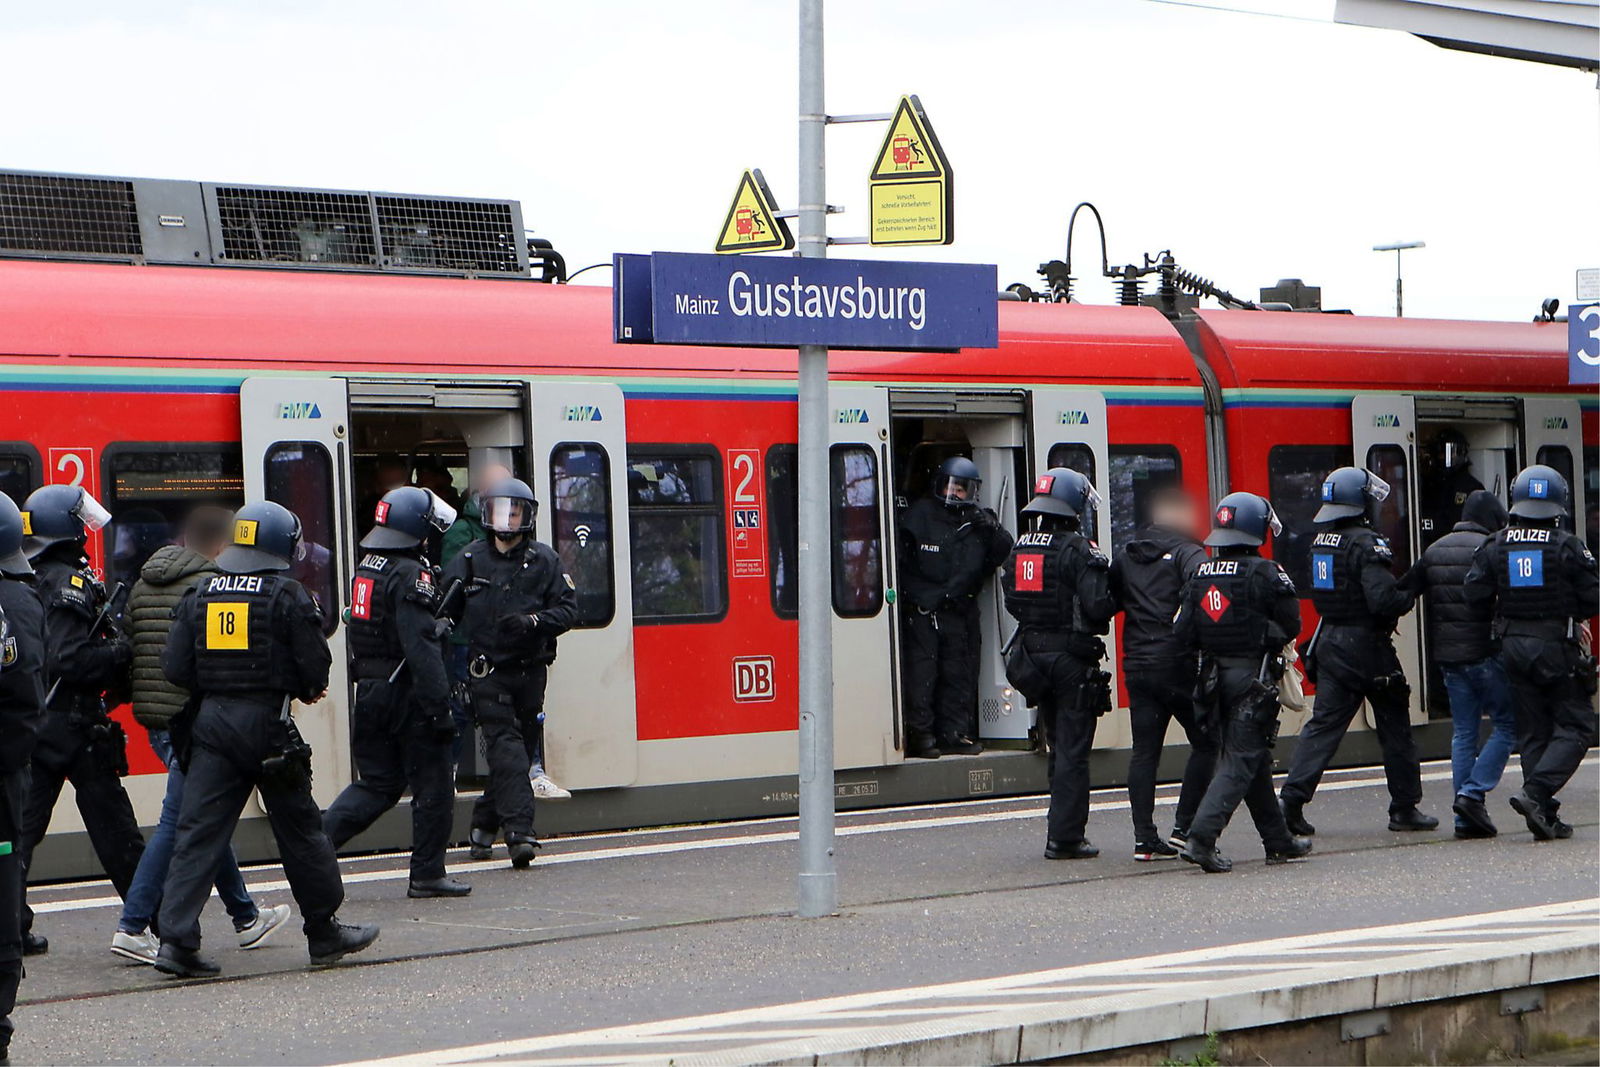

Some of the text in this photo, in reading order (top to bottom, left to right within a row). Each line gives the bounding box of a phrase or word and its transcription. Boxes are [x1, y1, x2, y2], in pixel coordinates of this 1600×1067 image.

[675, 270, 926, 331] Mainz Gustavsburg
[1577, 305, 1600, 366] 3
[57, 453, 84, 487] 2
[733, 454, 754, 502] 2
[1534, 483, 1543, 494] 18
[240, 526, 249, 539] 18
[1016, 533, 1053, 546] POLIZEI
[1506, 529, 1551, 543] POLIZEI
[1022, 560, 1034, 581] 18
[1198, 561, 1239, 576] POLIZEI
[1317, 561, 1327, 580] 18
[1517, 557, 1533, 577] 18
[208, 575, 263, 592] POLIZEI
[357, 583, 367, 605] 18
[1207, 590, 1222, 611] 18
[218, 611, 235, 636] 18
[738, 664, 770, 694] DB
